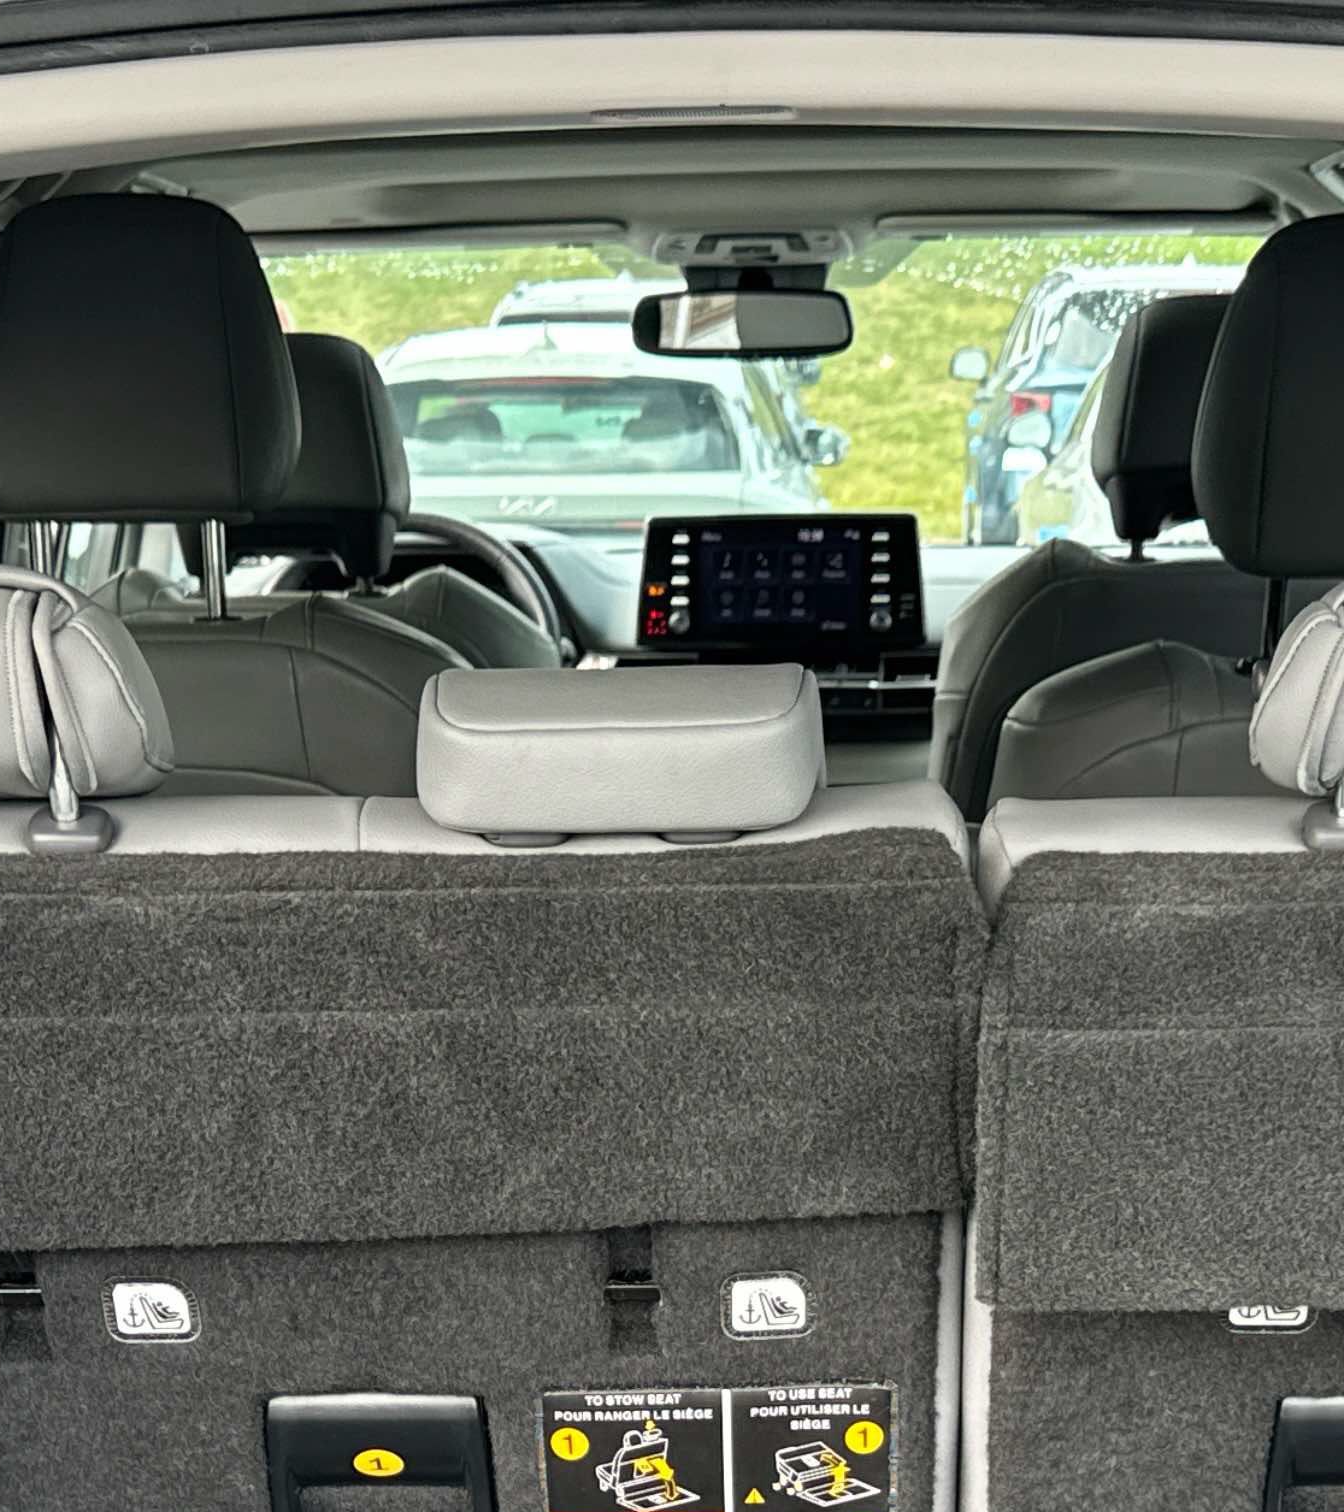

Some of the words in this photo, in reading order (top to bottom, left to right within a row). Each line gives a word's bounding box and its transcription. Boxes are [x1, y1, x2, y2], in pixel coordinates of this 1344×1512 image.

[584, 1395, 603, 1407] TO
[605, 1394, 645, 1407] STOW
[647, 1393, 682, 1405] SEAT
[768, 1390, 786, 1401] TO
[789, 1389, 816, 1400] USE
[818, 1387, 853, 1400] SEAT
[554, 1411, 592, 1422] POUR
[594, 1409, 652, 1421] RANGER
[653, 1409, 671, 1420] LE
[750, 1406, 788, 1418] POUR
[790, 1404, 851, 1416] UTILISER
[853, 1403, 870, 1415] LE
